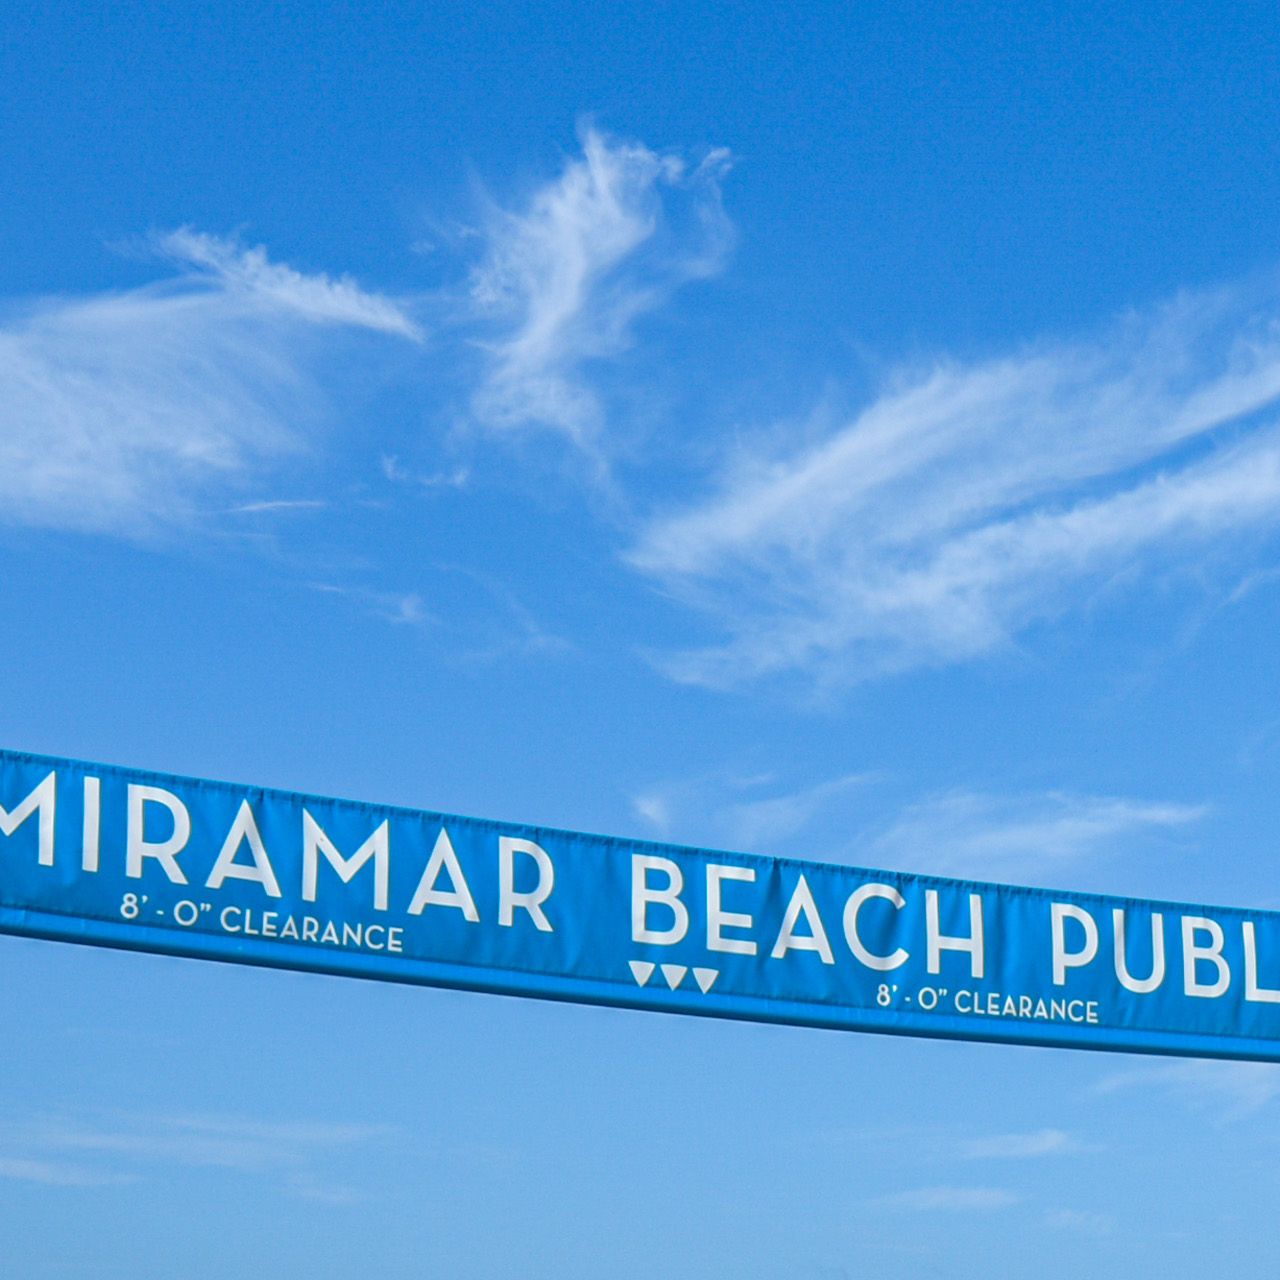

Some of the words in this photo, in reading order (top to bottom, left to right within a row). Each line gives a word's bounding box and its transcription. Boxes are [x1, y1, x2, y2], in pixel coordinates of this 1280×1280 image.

[0, 770, 555, 932] MIRAMAR
[631, 853, 984, 979] BEACH
[220, 905, 404, 952] CLEARANCE
[954, 990, 1099, 1024] CLEARANCE
